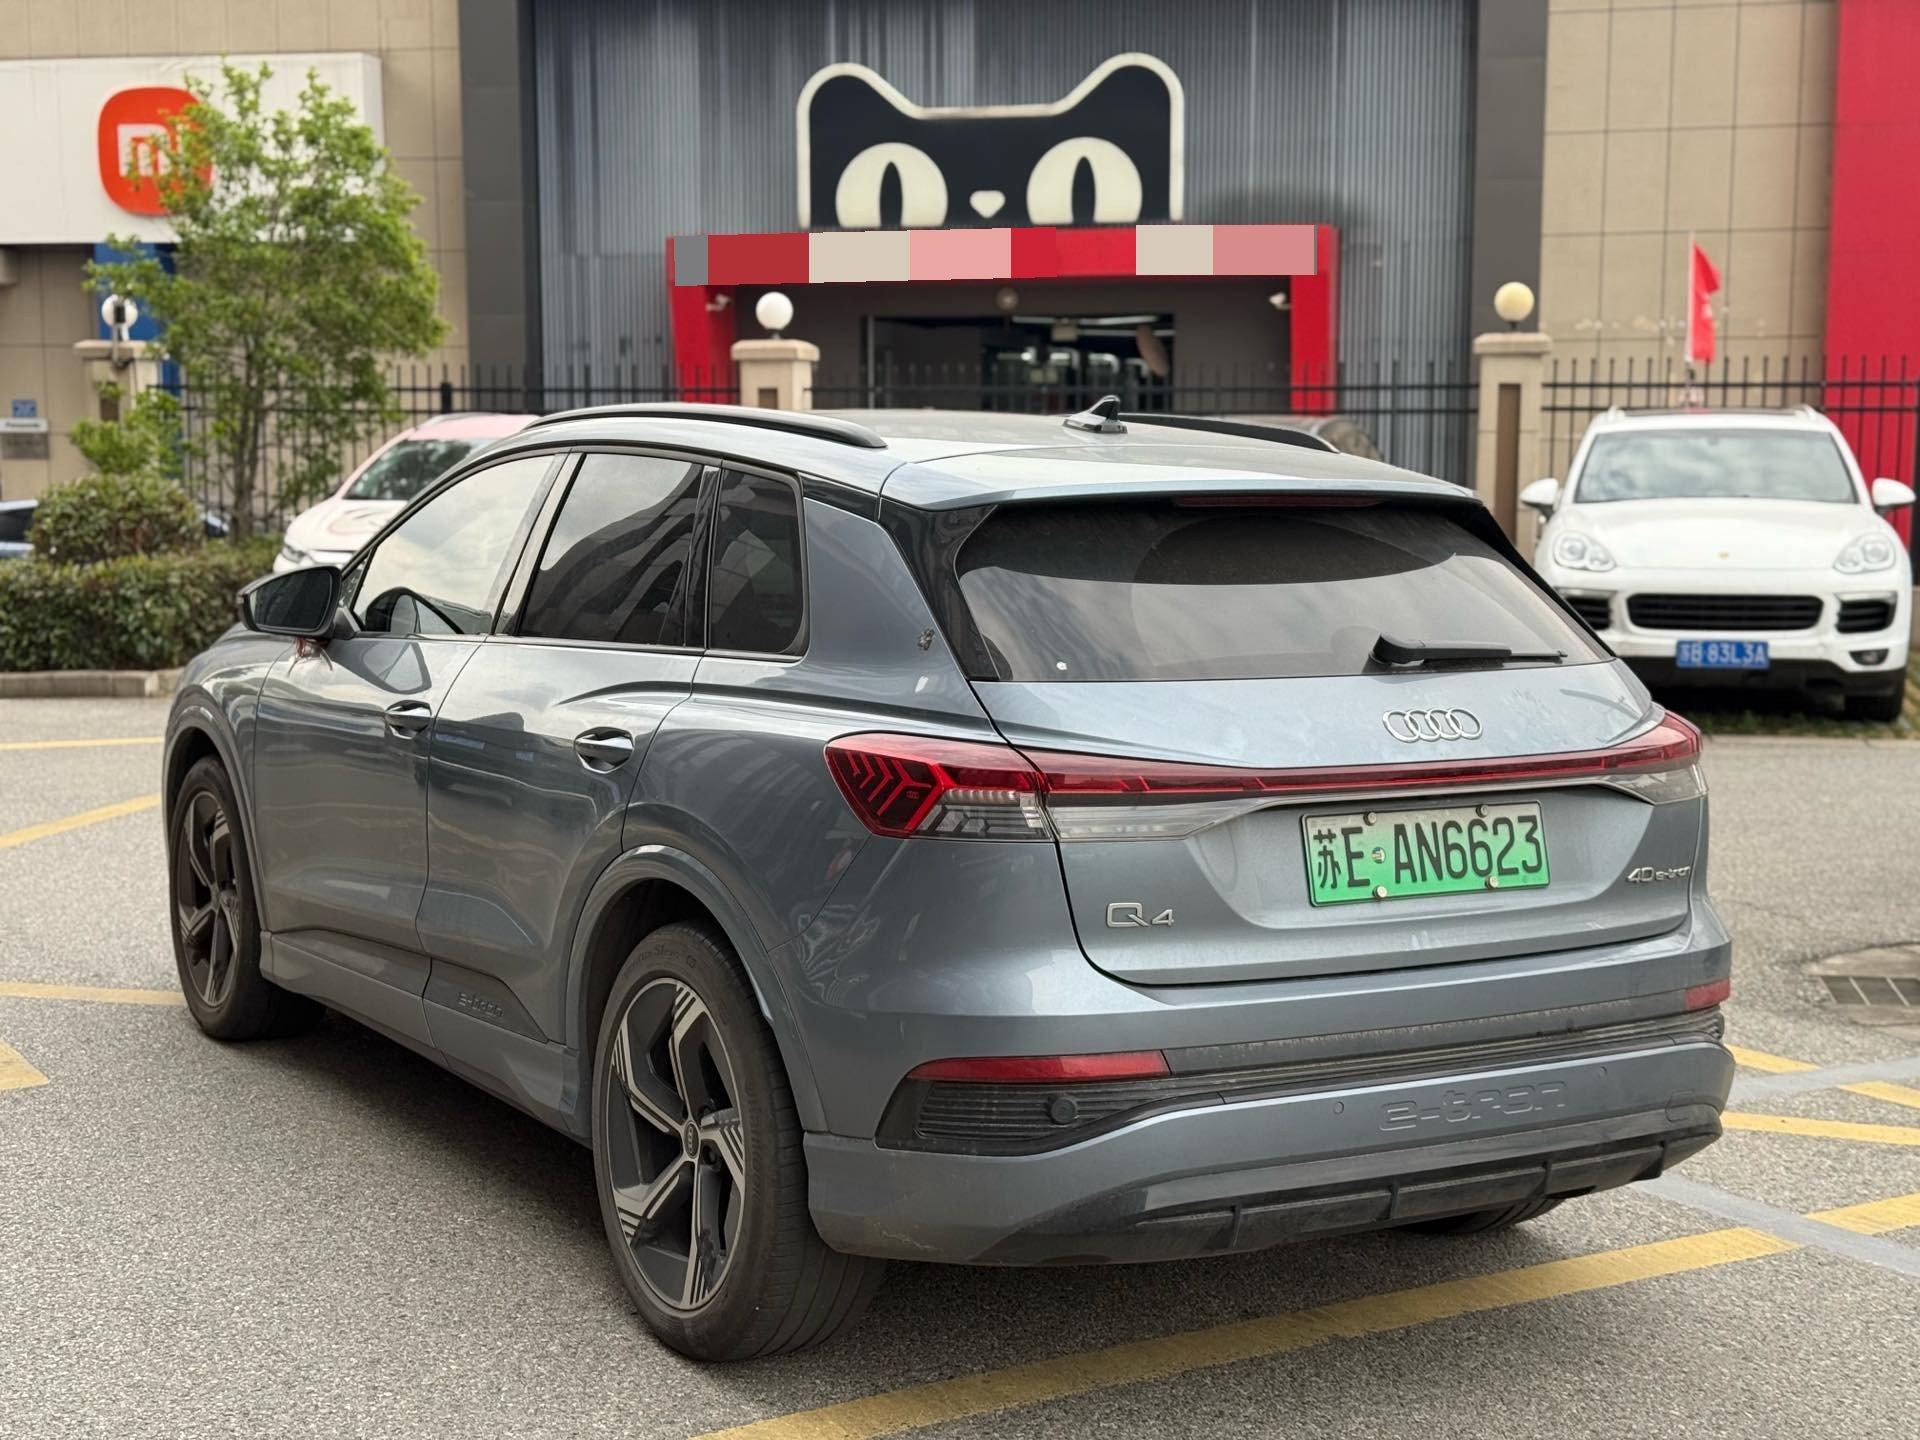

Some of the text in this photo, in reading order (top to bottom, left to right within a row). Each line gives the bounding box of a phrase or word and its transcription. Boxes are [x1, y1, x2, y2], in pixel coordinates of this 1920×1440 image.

[1313, 815, 1543, 889] 苏E AN6623
[1627, 867, 1653, 883] 40
[1107, 902, 1175, 928] Q4
[1379, 1081, 1567, 1131] e-tron
